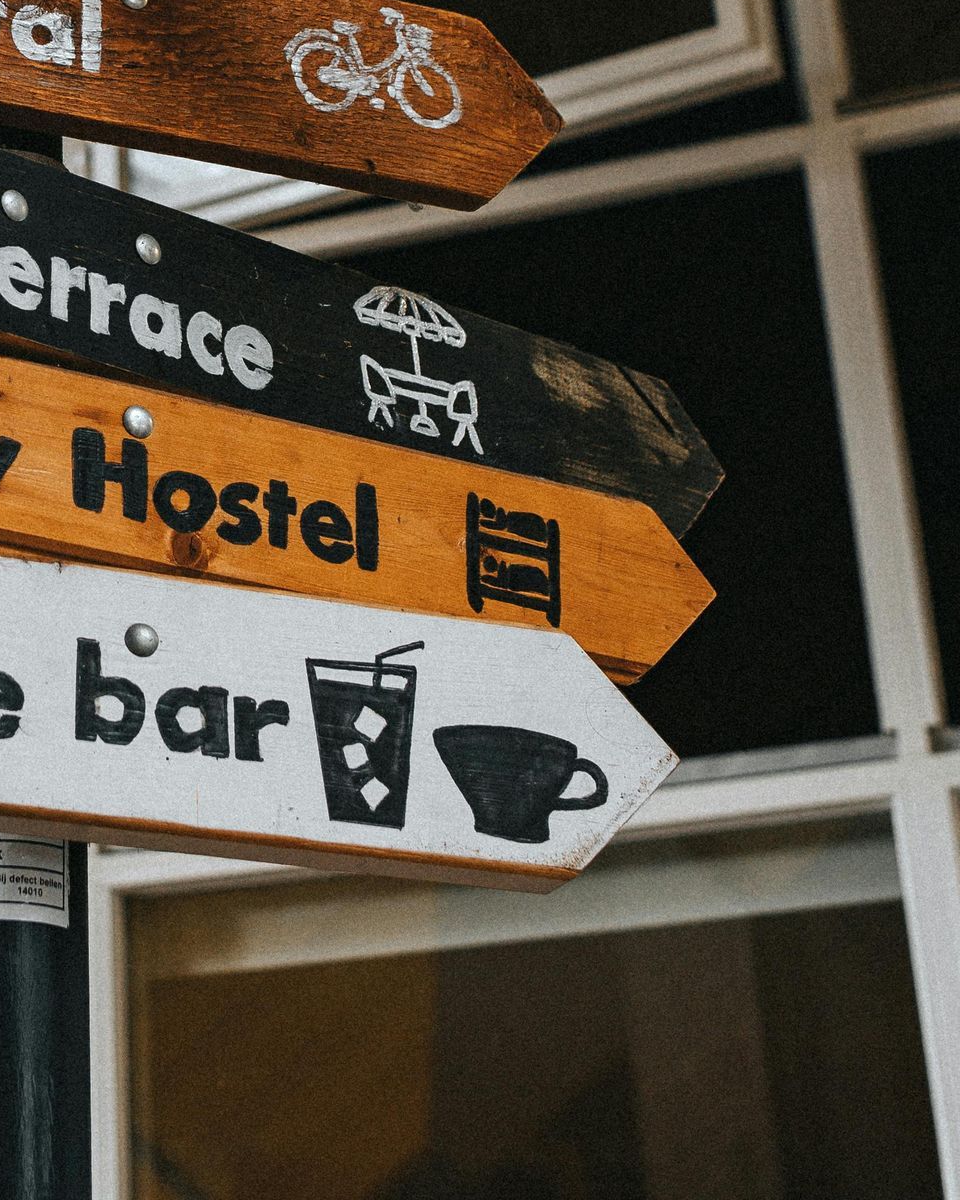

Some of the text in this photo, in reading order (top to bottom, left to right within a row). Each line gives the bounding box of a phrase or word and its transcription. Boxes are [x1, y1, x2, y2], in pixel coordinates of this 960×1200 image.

[72, 427, 380, 572] Hostel
[75, 637, 290, 761] bar
[9, 874, 38, 885] defect
[17, 886, 43, 897] 14010
